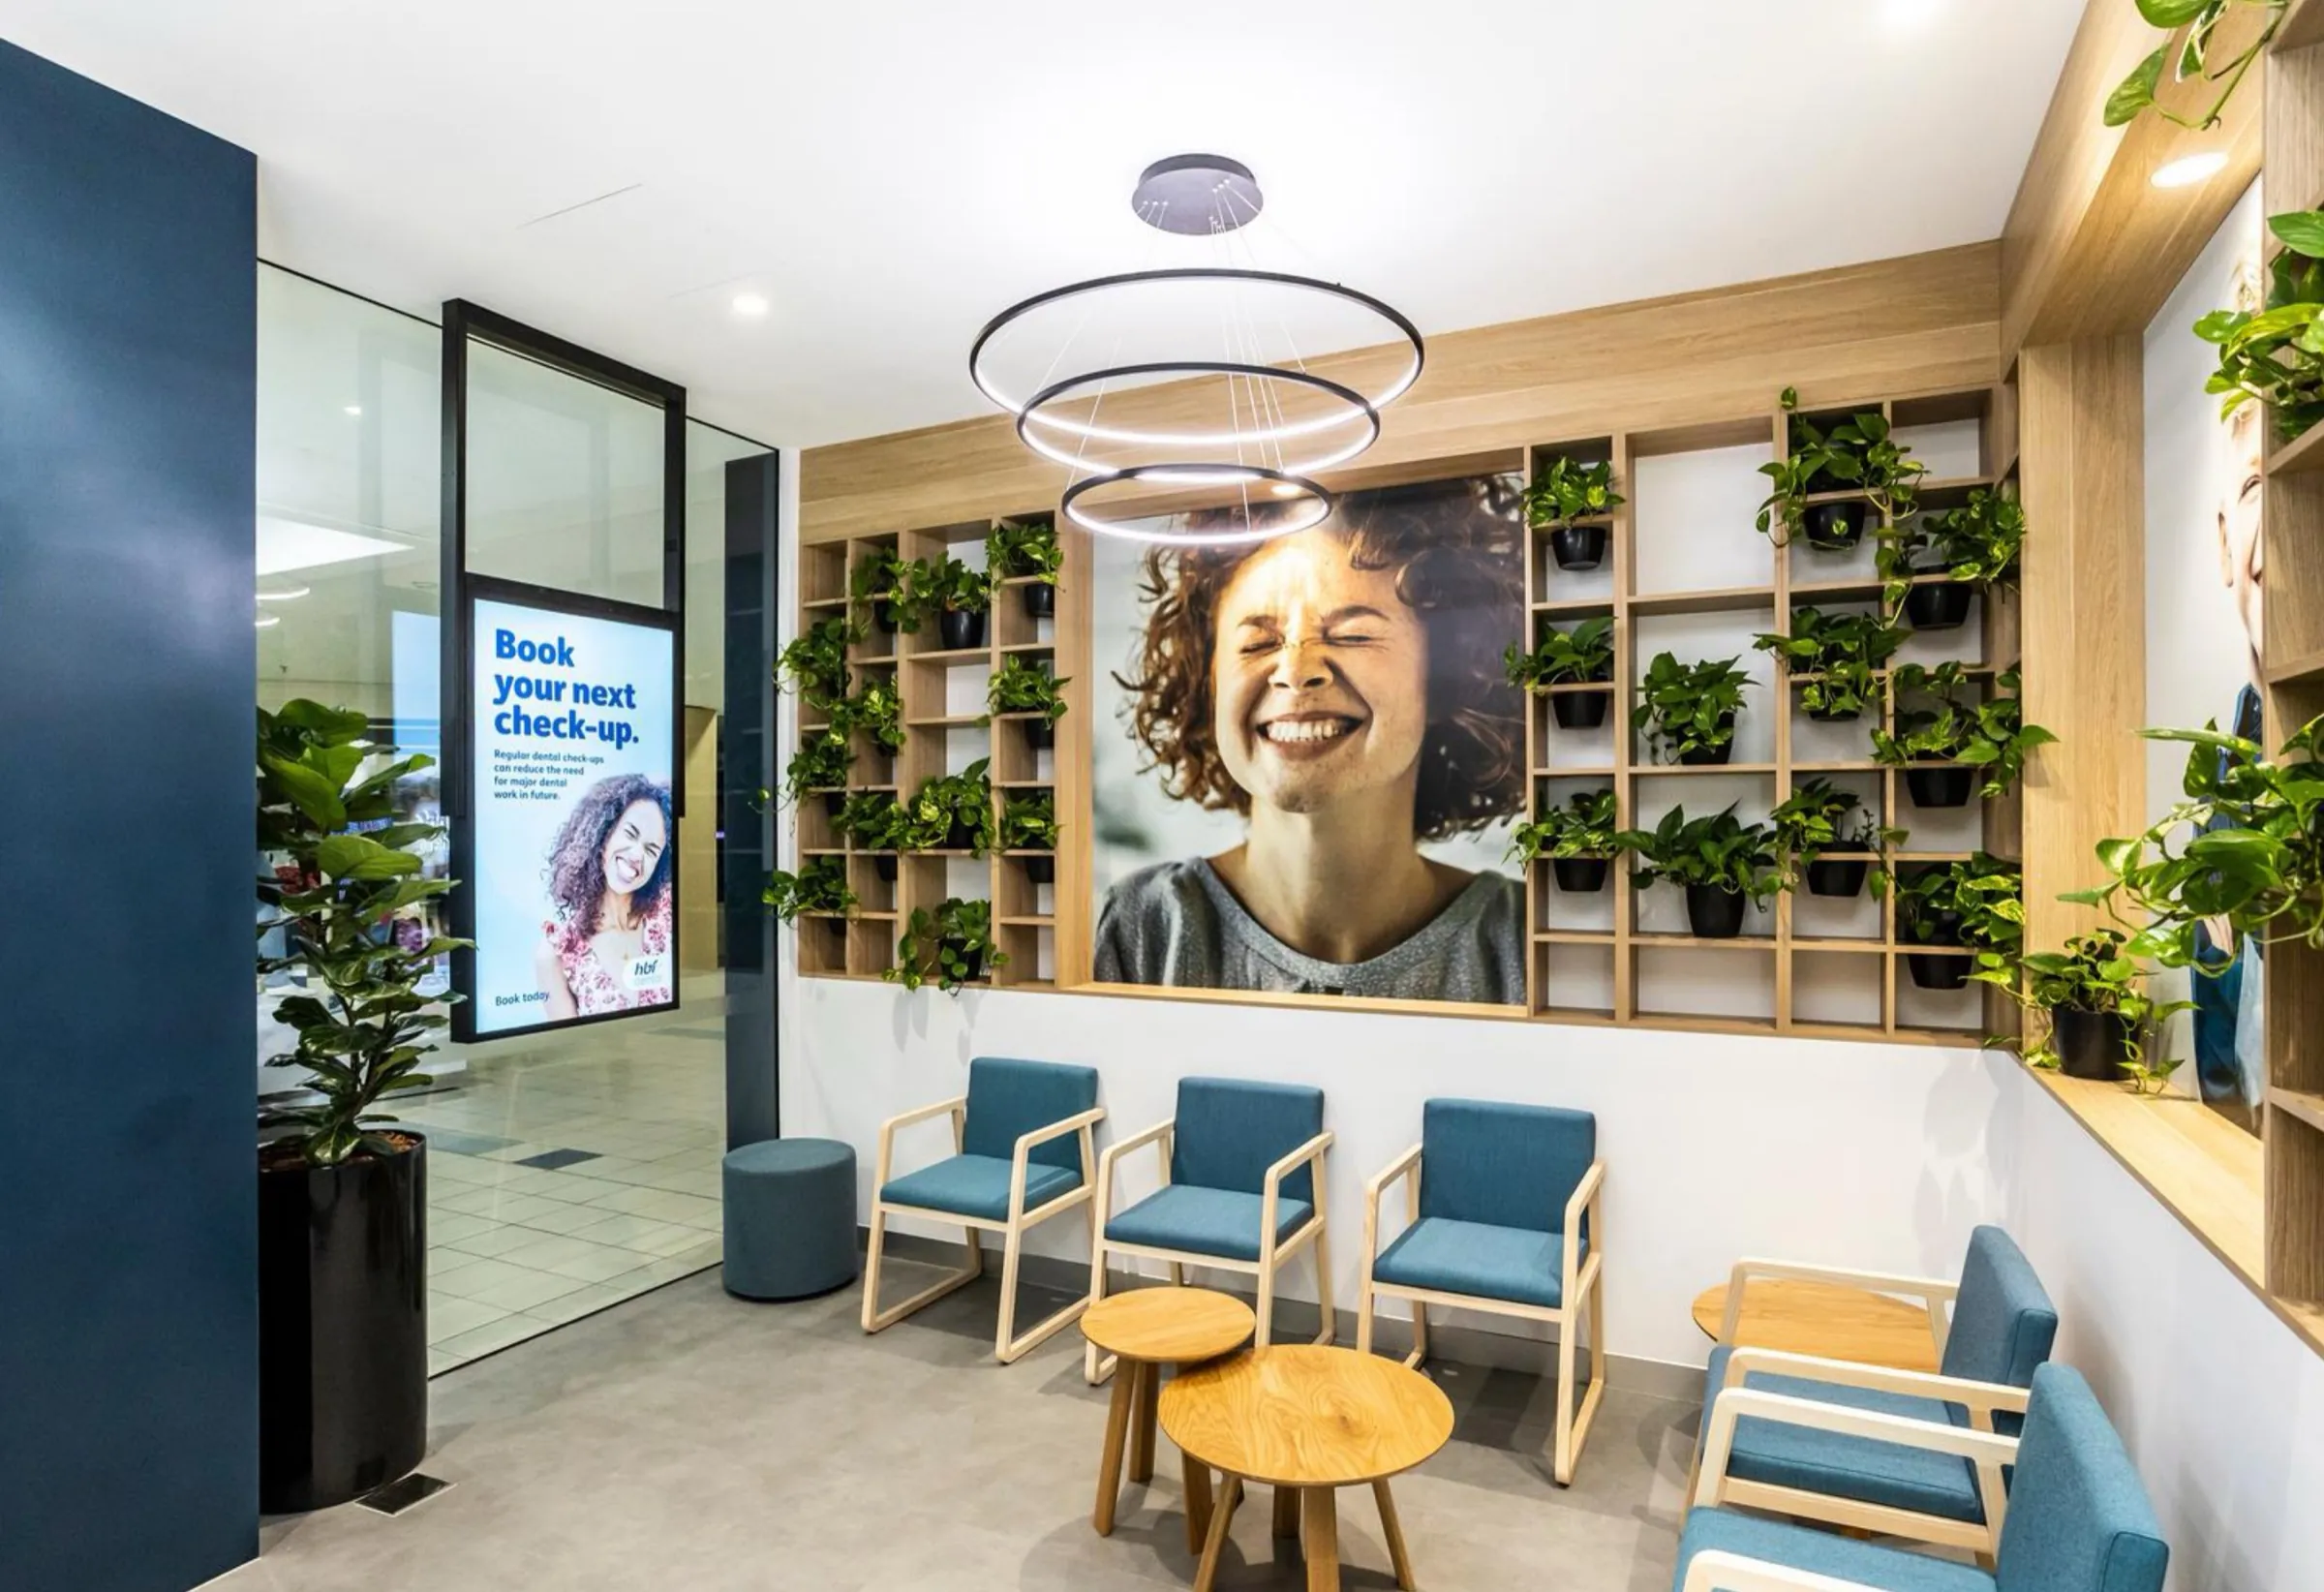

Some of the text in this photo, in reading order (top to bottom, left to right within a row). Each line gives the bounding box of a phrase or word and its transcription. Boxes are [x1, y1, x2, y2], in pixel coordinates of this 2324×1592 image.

[496, 628, 575, 667] Book
[493, 674, 636, 709] your next
[494, 705, 639, 750] check-up.
[494, 750, 604, 765] Regular dental check-ups
[494, 764, 584, 775] can reduce the need
[494, 776, 567, 788] for major dental
[494, 789, 561, 800] work in future.
[496, 992, 549, 1006] Book today
